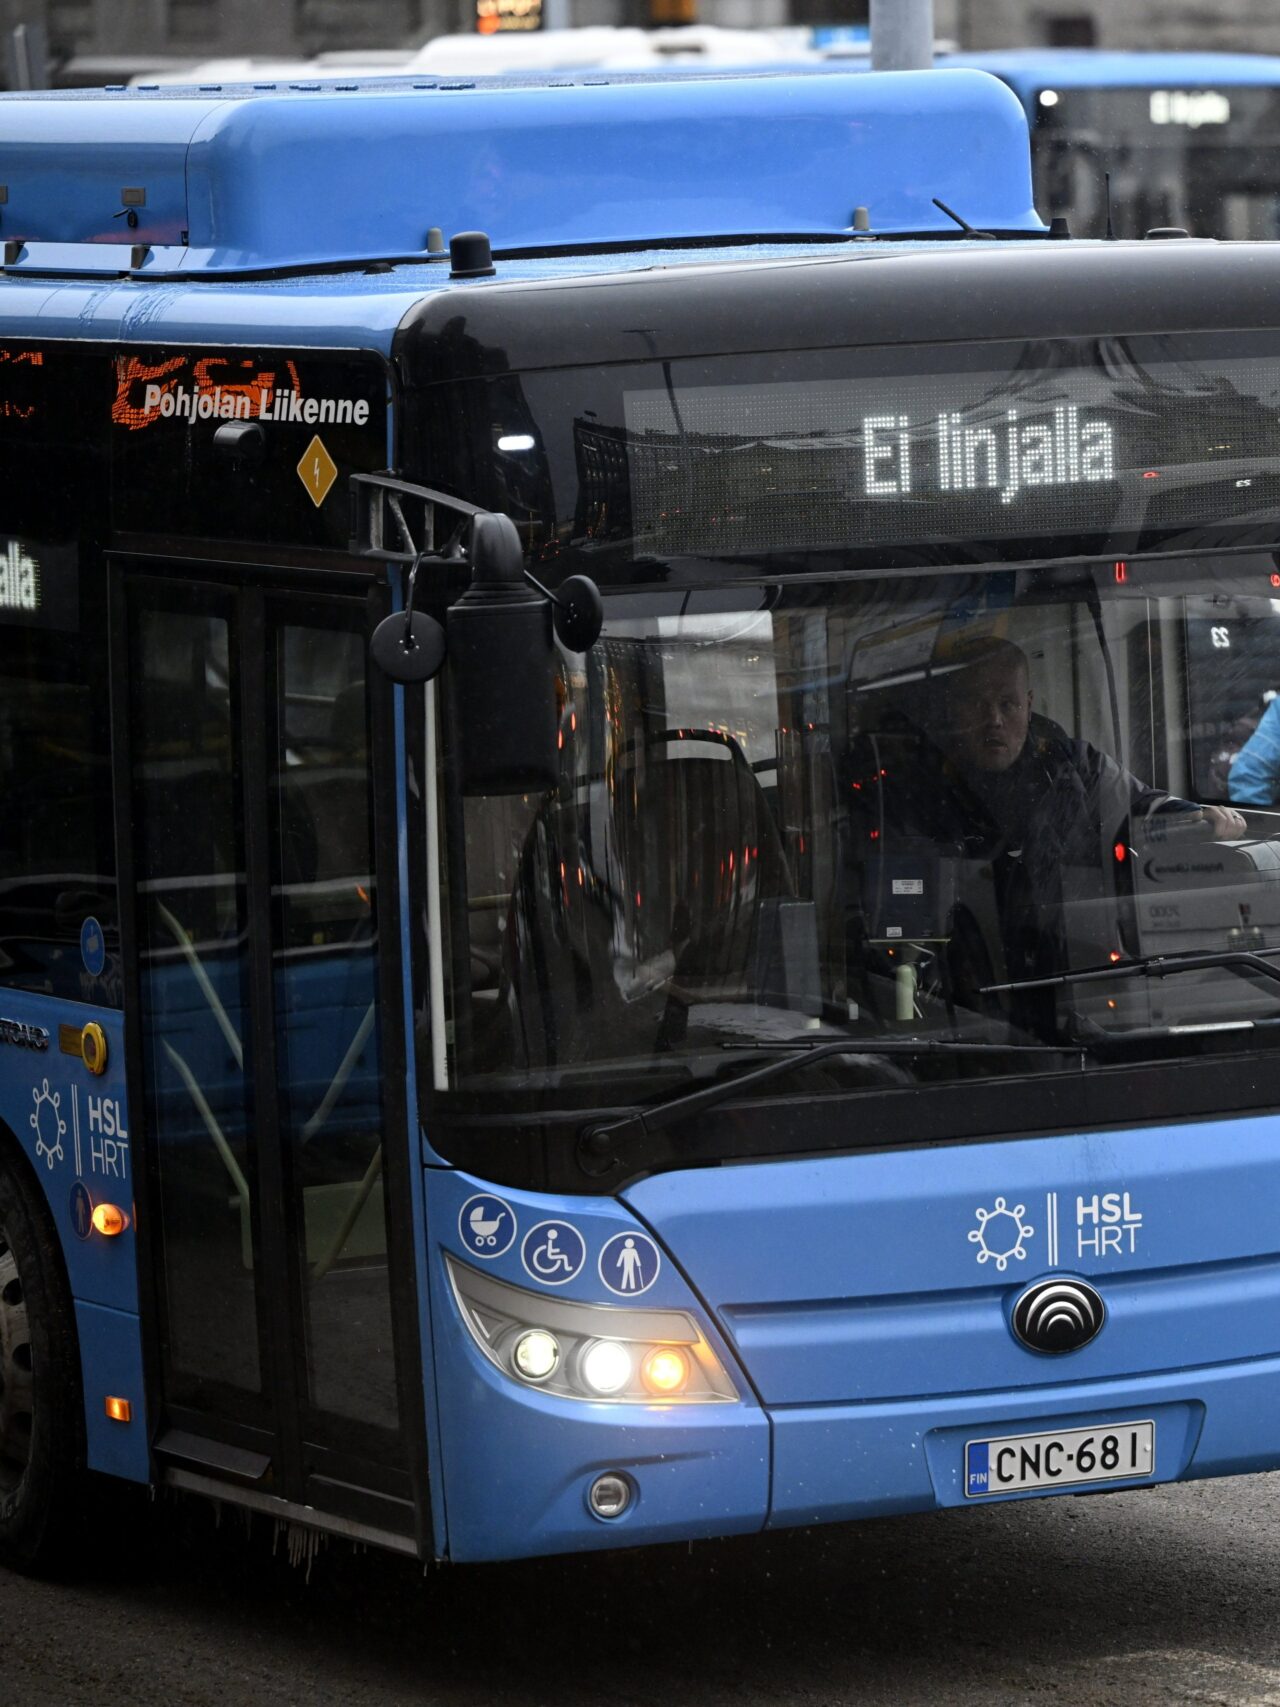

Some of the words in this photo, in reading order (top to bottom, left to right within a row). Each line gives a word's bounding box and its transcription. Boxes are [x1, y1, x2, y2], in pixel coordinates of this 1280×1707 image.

[144, 384, 249, 424] Pohjolan
[259, 388, 370, 426] Liikenne
[863, 415, 911, 494] Ei
[938, 405, 1113, 503] linjalla
[88, 1095, 128, 1139] HSL
[90, 1135, 129, 1179] HRT
[1076, 1191, 1143, 1226] HSL
[1077, 1222, 1143, 1258] HRT
[969, 1472, 988, 1485] FIN
[997, 1432, 1138, 1483] CNC-681
